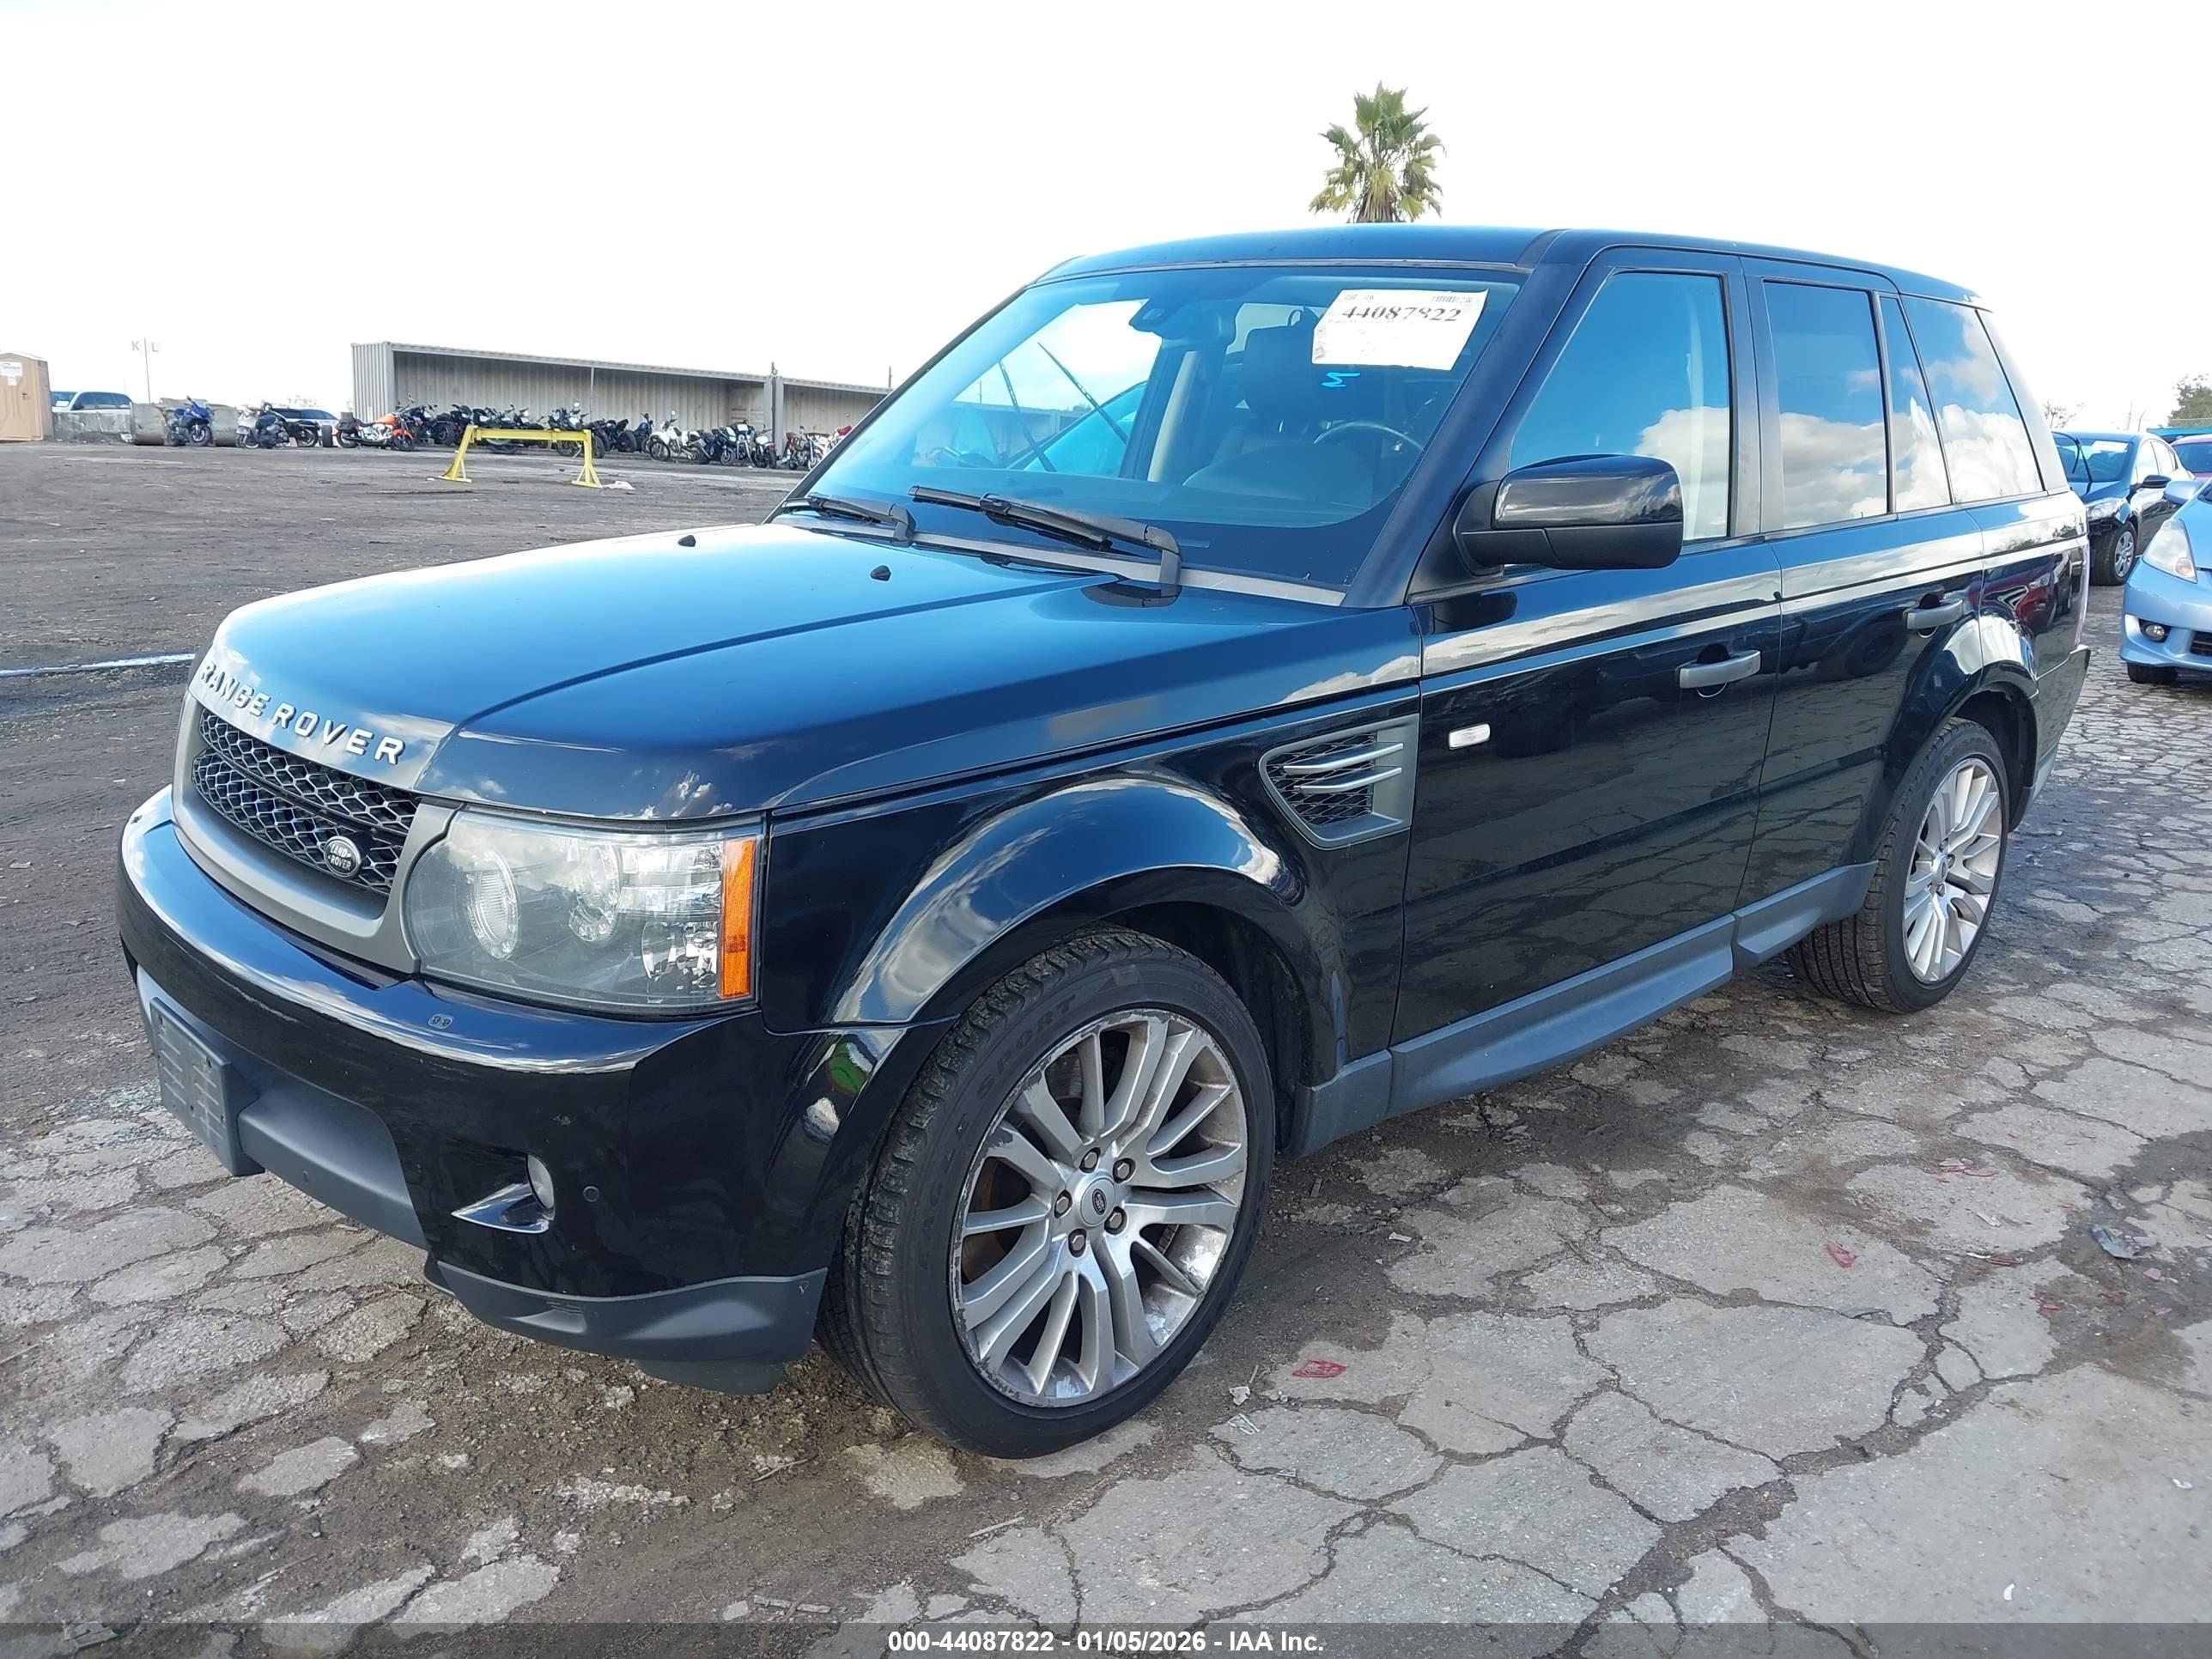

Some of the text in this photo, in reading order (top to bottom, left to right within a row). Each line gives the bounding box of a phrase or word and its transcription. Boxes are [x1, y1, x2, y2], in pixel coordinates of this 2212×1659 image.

[1341, 306, 1462, 322] 44087822
[131, 341, 140, 351] K
[151, 343, 159, 353] L
[200, 661, 405, 765] RANGE ROVER
[330, 843, 349, 858] LAND
[330, 854, 352, 871] ROVER
